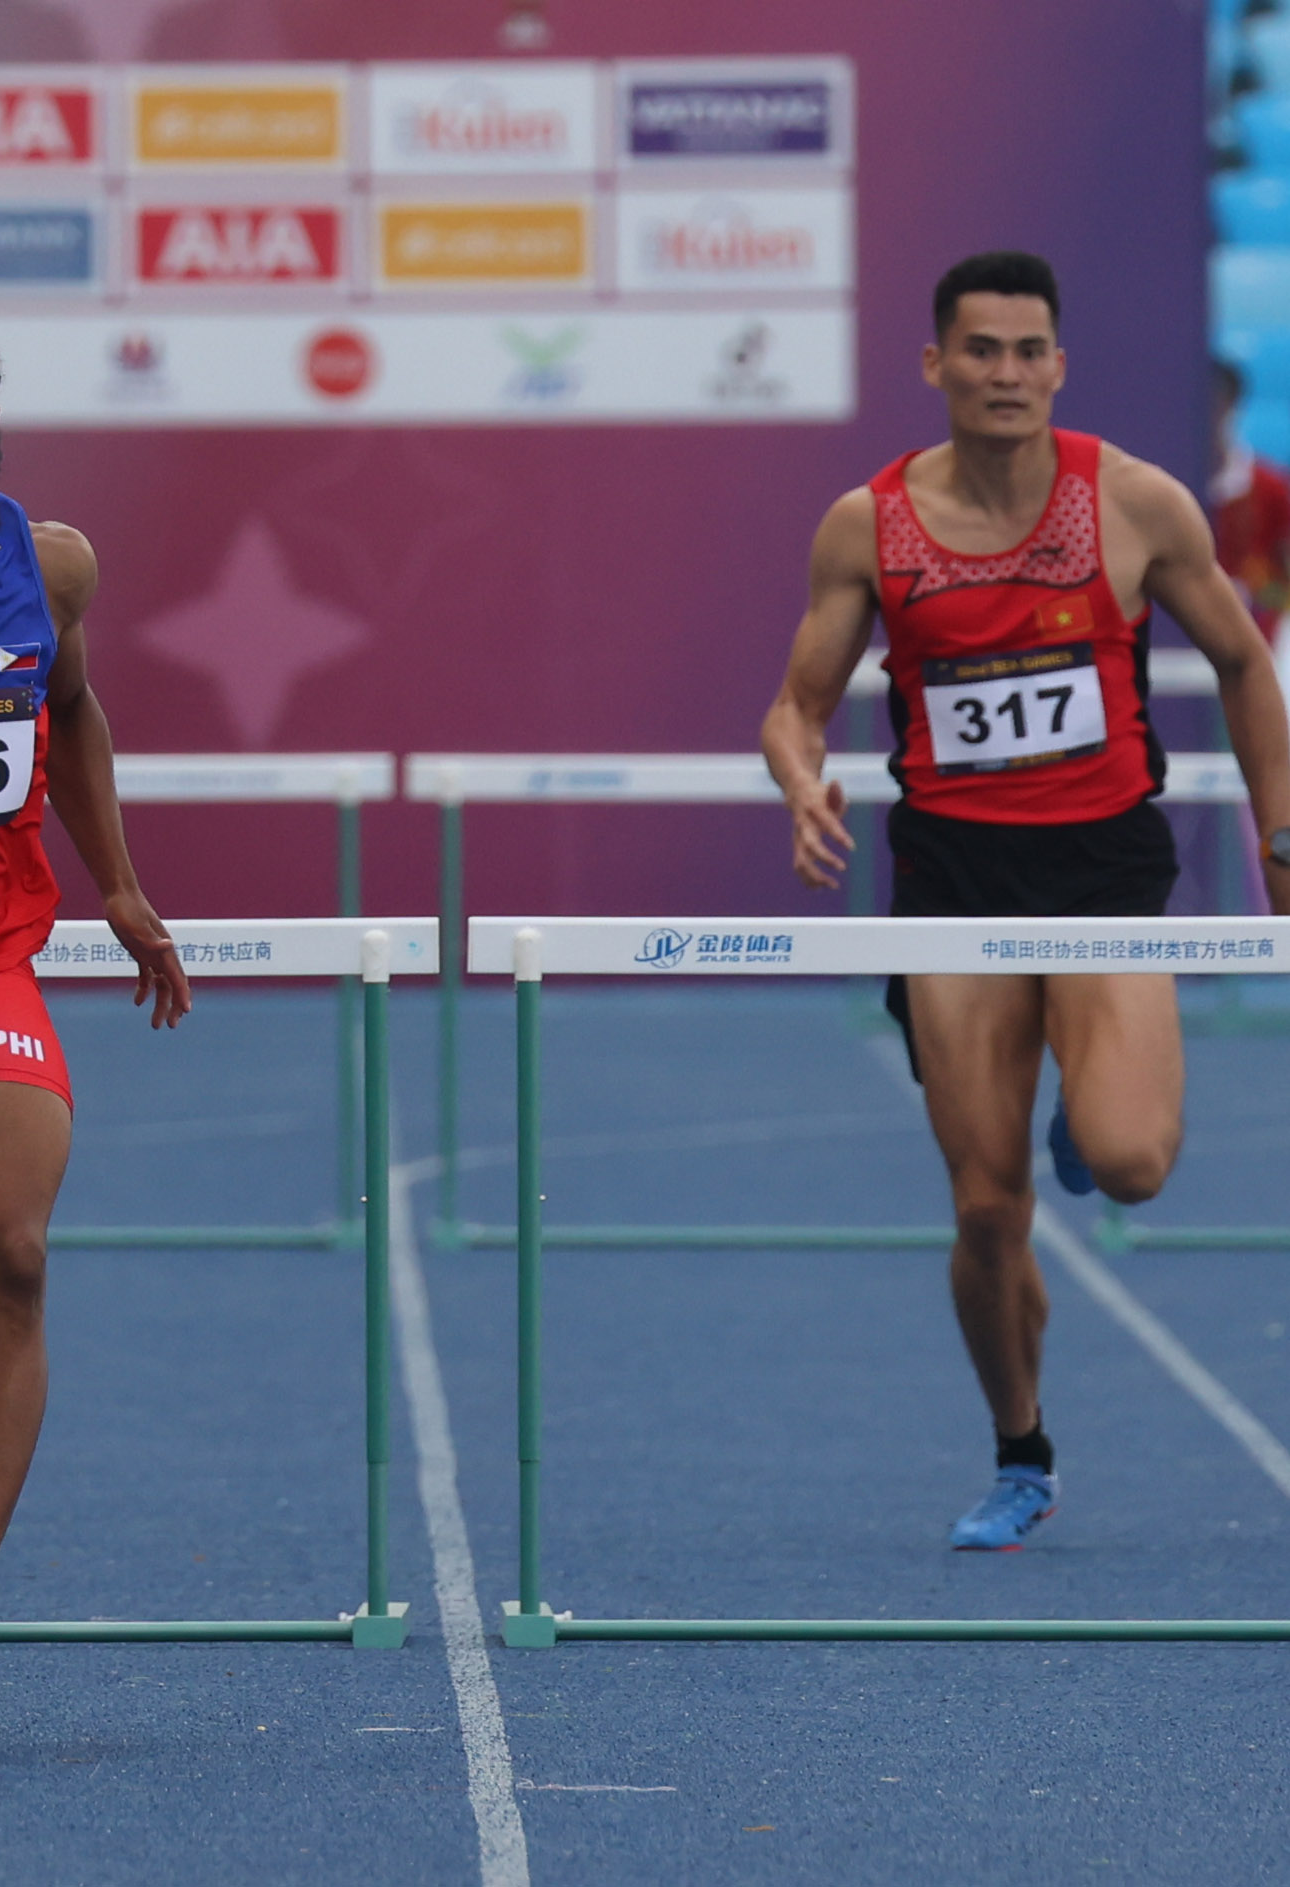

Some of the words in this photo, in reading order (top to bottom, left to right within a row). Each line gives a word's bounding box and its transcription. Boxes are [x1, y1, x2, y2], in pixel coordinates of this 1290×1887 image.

[154, 208, 323, 274] AIA
[953, 685, 1074, 744] 317
[696, 934, 793, 953] 金陵体育
[981, 938, 1275, 960] 中国田径协会田径器材类官方供应商
